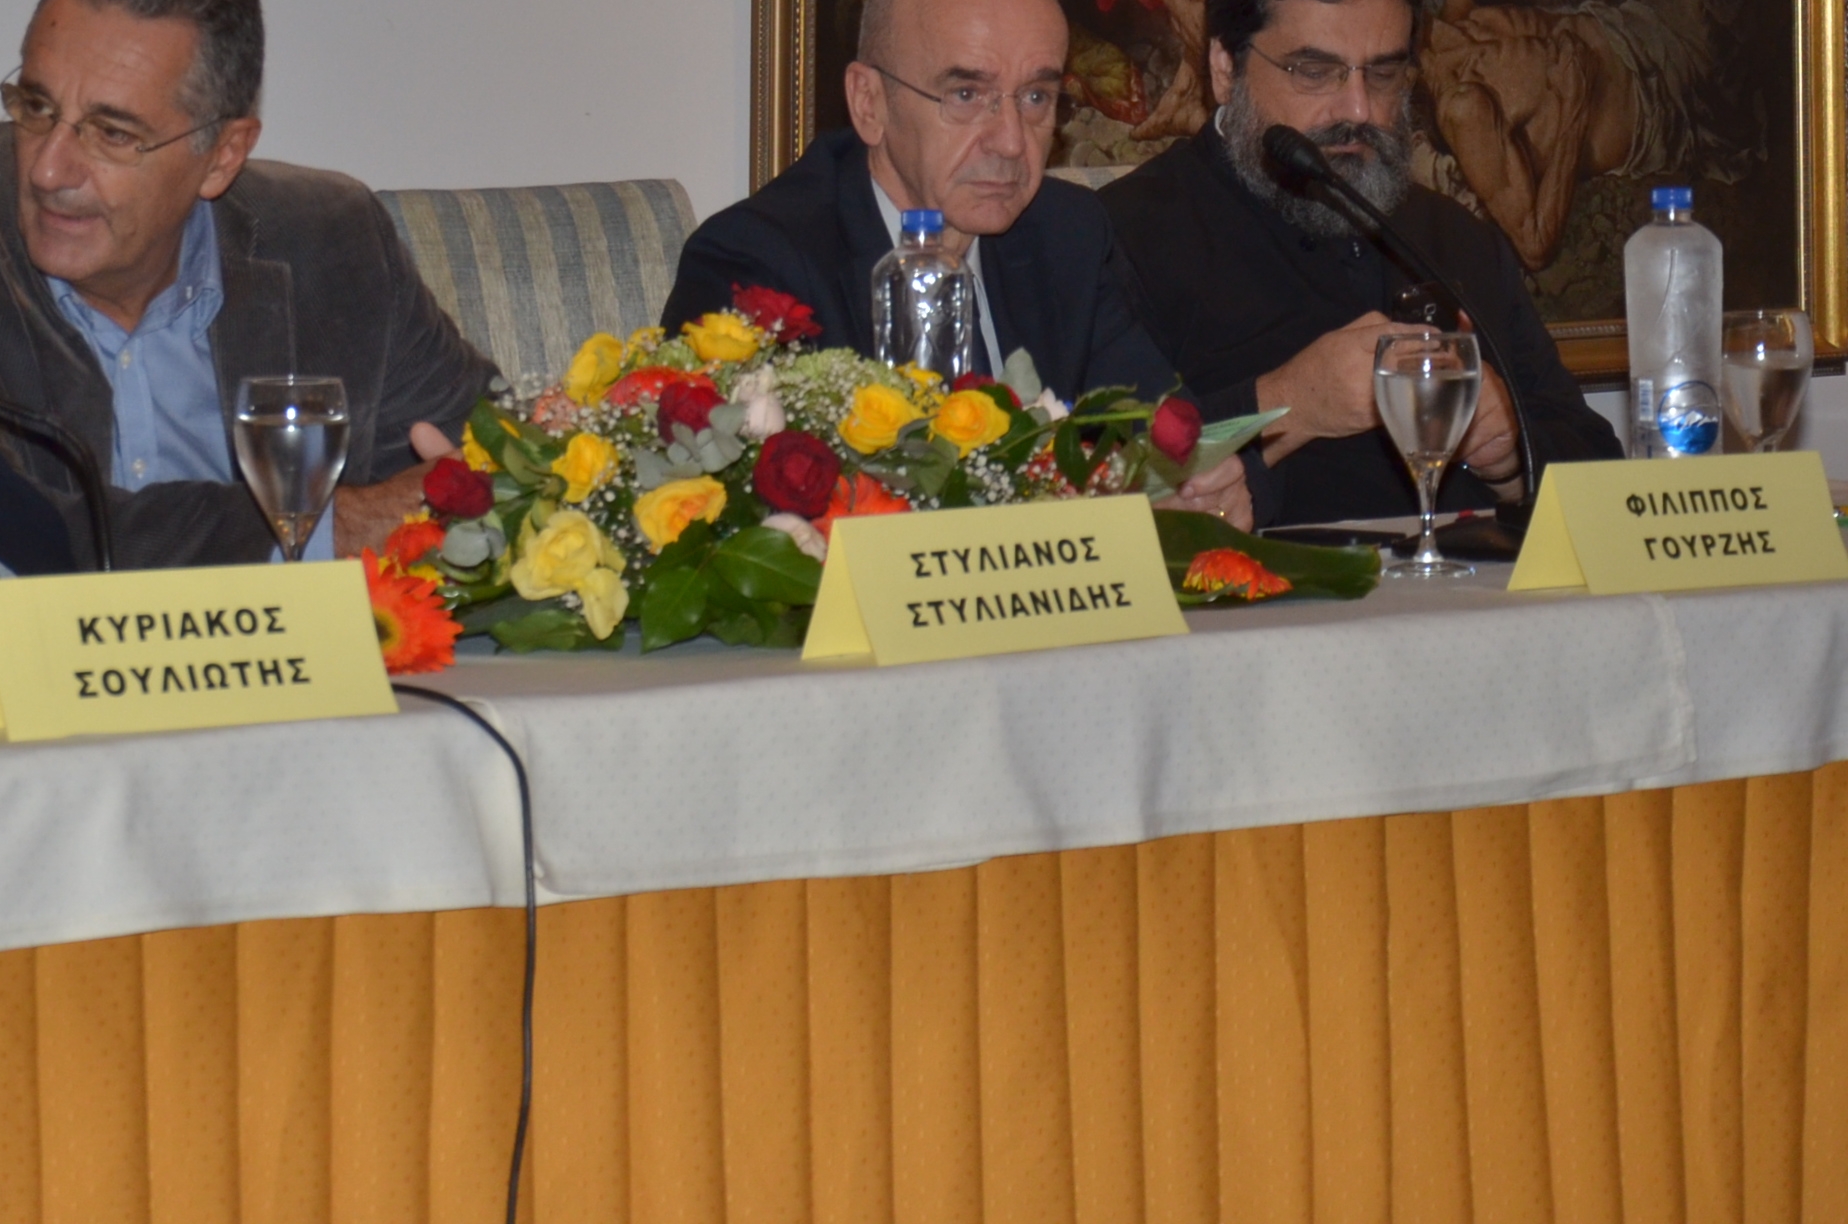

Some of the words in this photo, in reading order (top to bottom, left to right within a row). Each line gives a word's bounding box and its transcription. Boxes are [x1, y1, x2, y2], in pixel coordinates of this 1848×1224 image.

[1624, 485, 1769, 518] ΦΙΛΙΠΠΟΣ
[909, 535, 1101, 579] ΣΤΥΛΙΑΝΟΣ
[1642, 529, 1777, 562] ΓΟΥΡΖΗΣ
[77, 605, 287, 646] ΚΥΡΙΑΚΟΣ
[905, 581, 1133, 629] ΣΤΥΛΙΑΝΙΔΗΣ
[73, 656, 312, 699] ΣΟΥΛΙΩΤΗΣ
